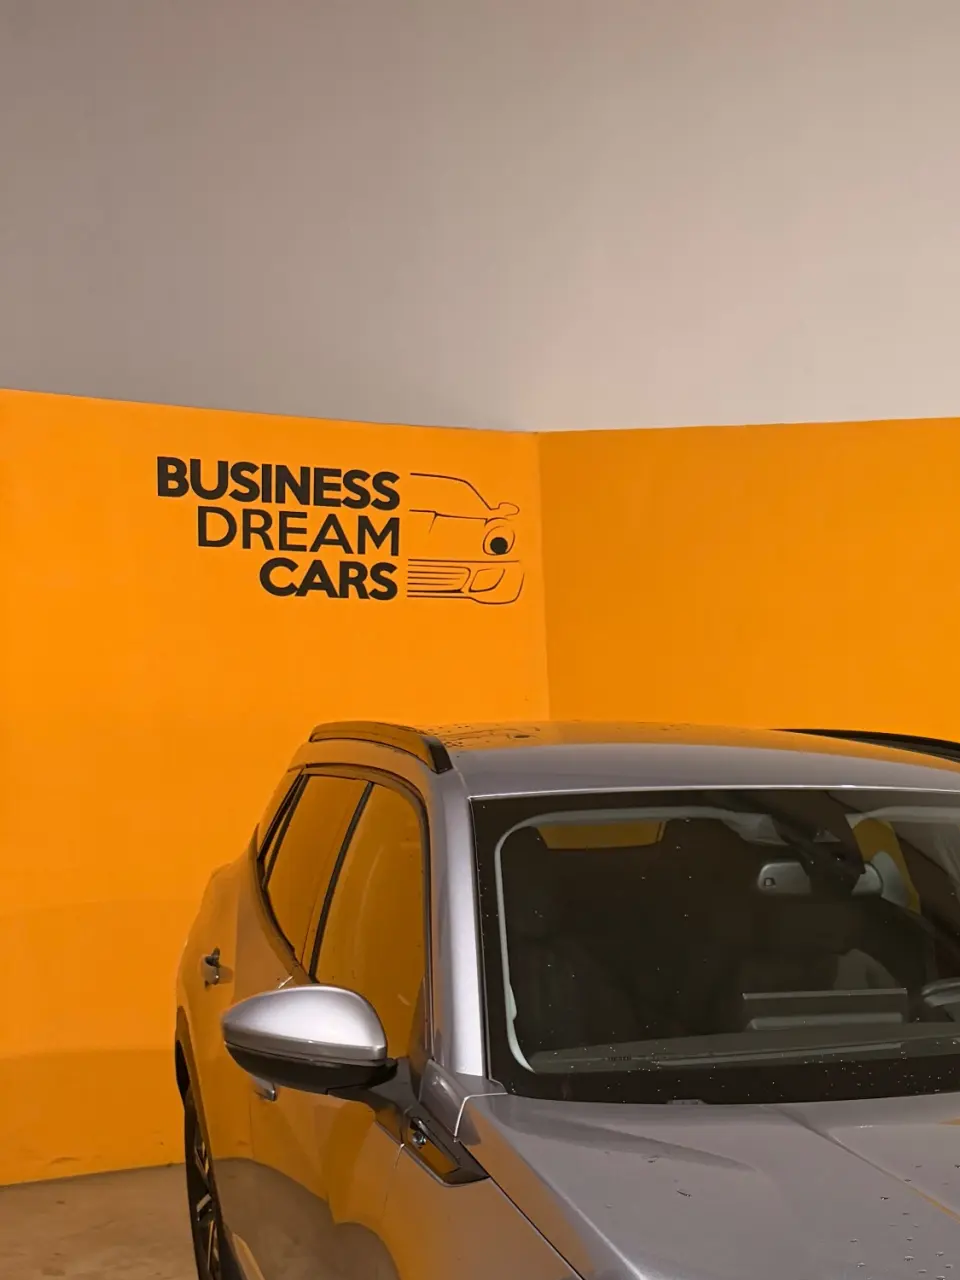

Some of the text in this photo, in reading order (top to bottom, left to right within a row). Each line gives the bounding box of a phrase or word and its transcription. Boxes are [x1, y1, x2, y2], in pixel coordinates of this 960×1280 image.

[157, 456, 400, 510] BUSINESS
[197, 506, 400, 556] DREAM
[259, 557, 398, 601] CARS
